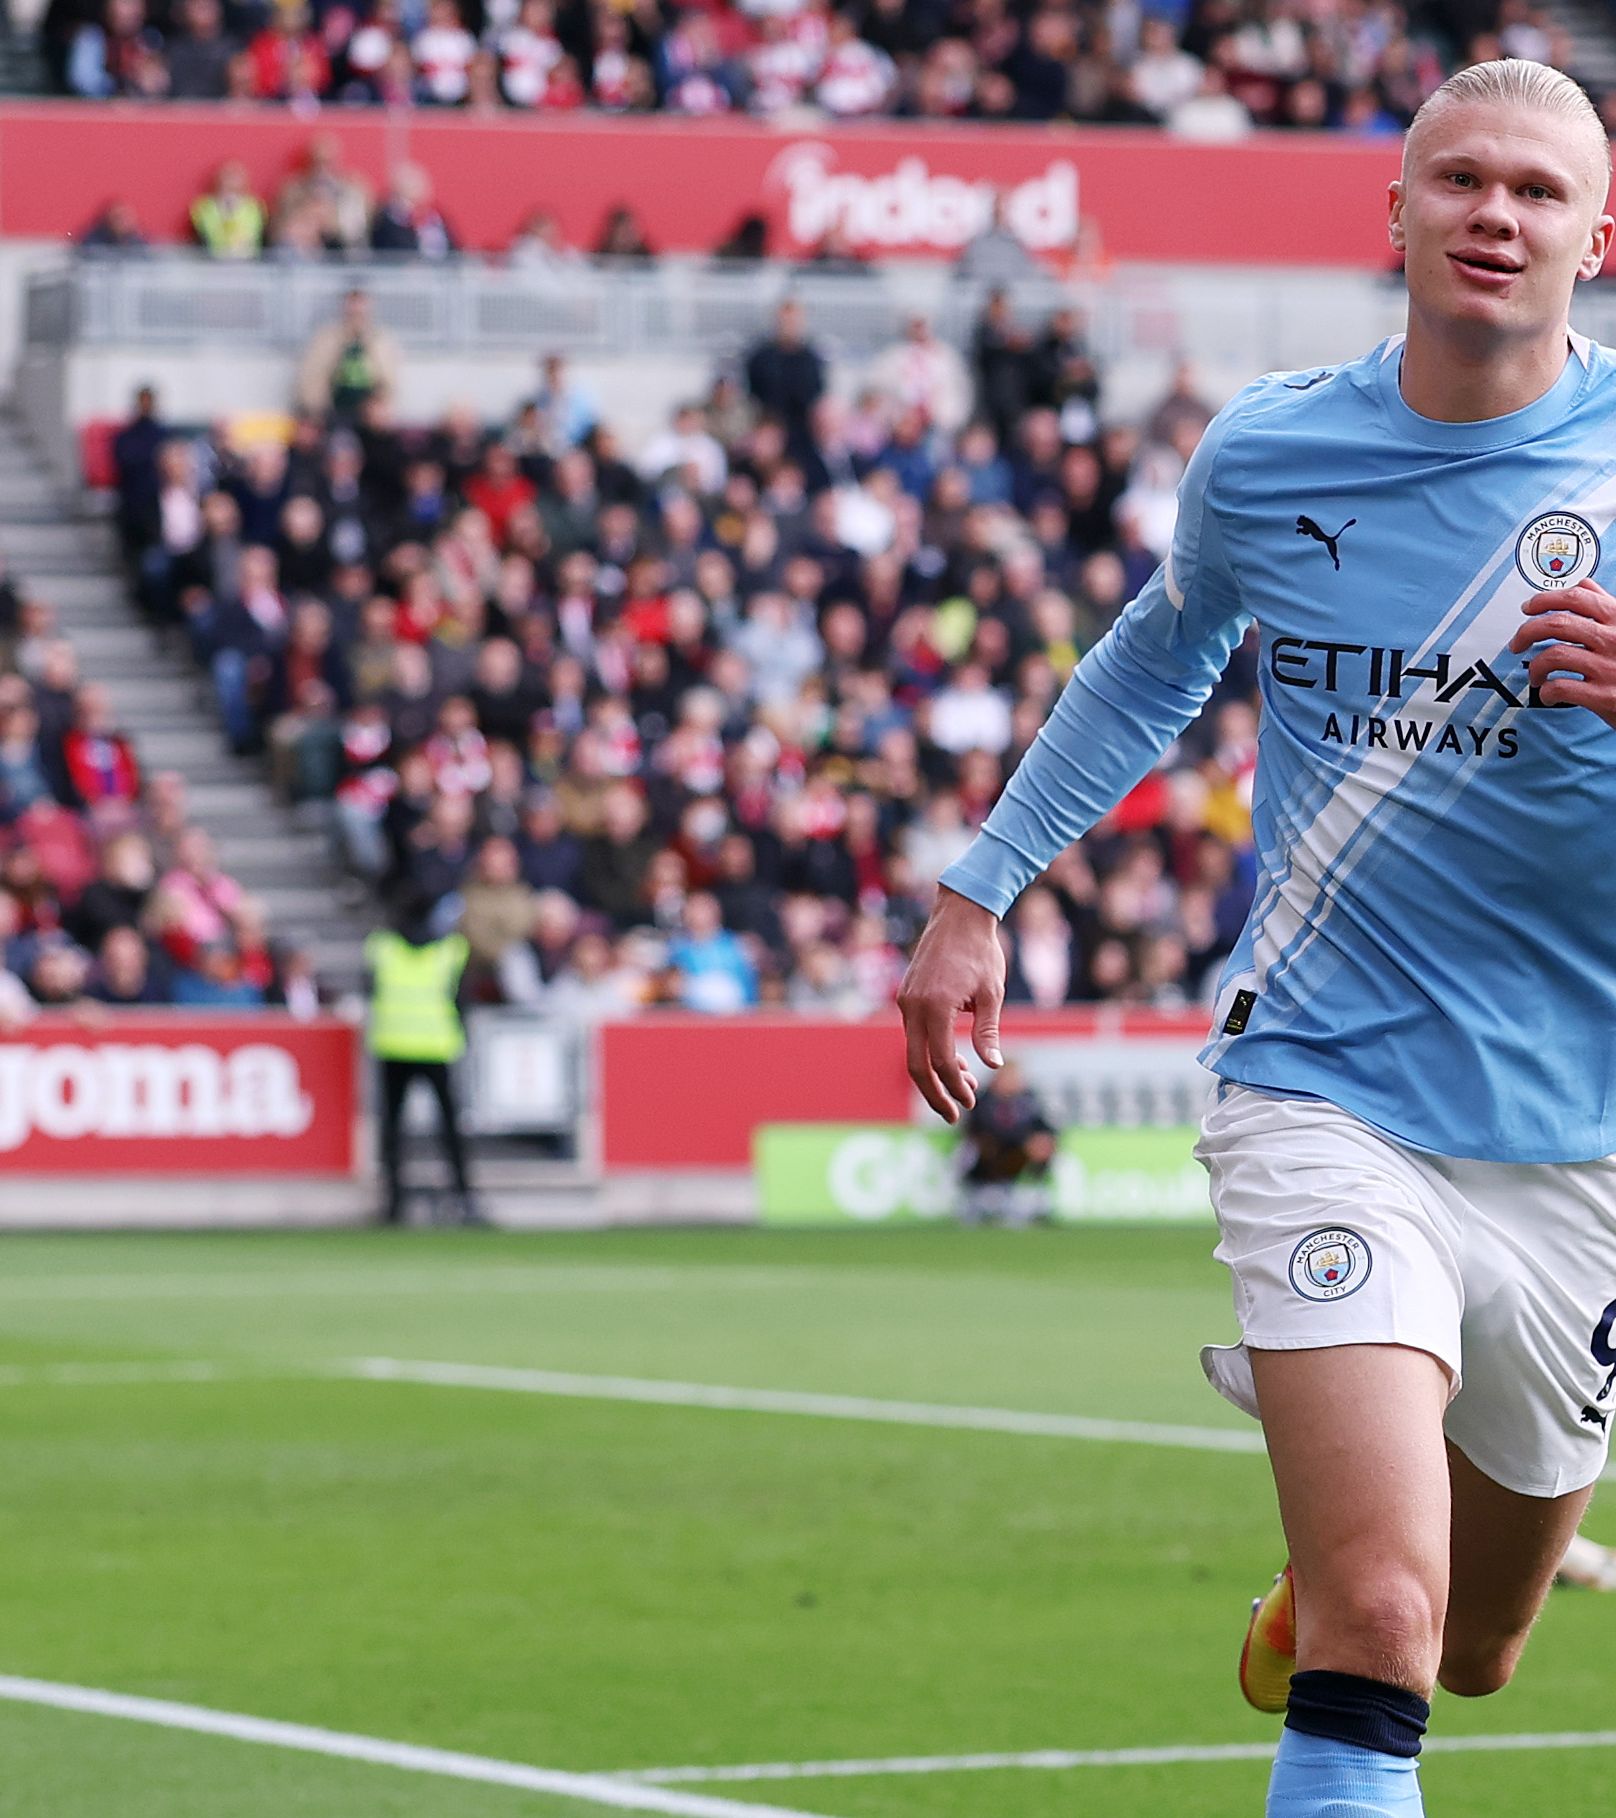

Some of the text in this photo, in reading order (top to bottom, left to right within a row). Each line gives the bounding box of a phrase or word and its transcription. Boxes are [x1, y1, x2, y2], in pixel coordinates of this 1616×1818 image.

[1527, 518, 1592, 545] MANCHESTER
[1543, 579, 1567, 588] CITY
[1320, 712, 1520, 759] AIRWAYS
[1296, 1233, 1360, 1264] MANCHESTER
[1323, 1285, 1347, 1297] CITY
